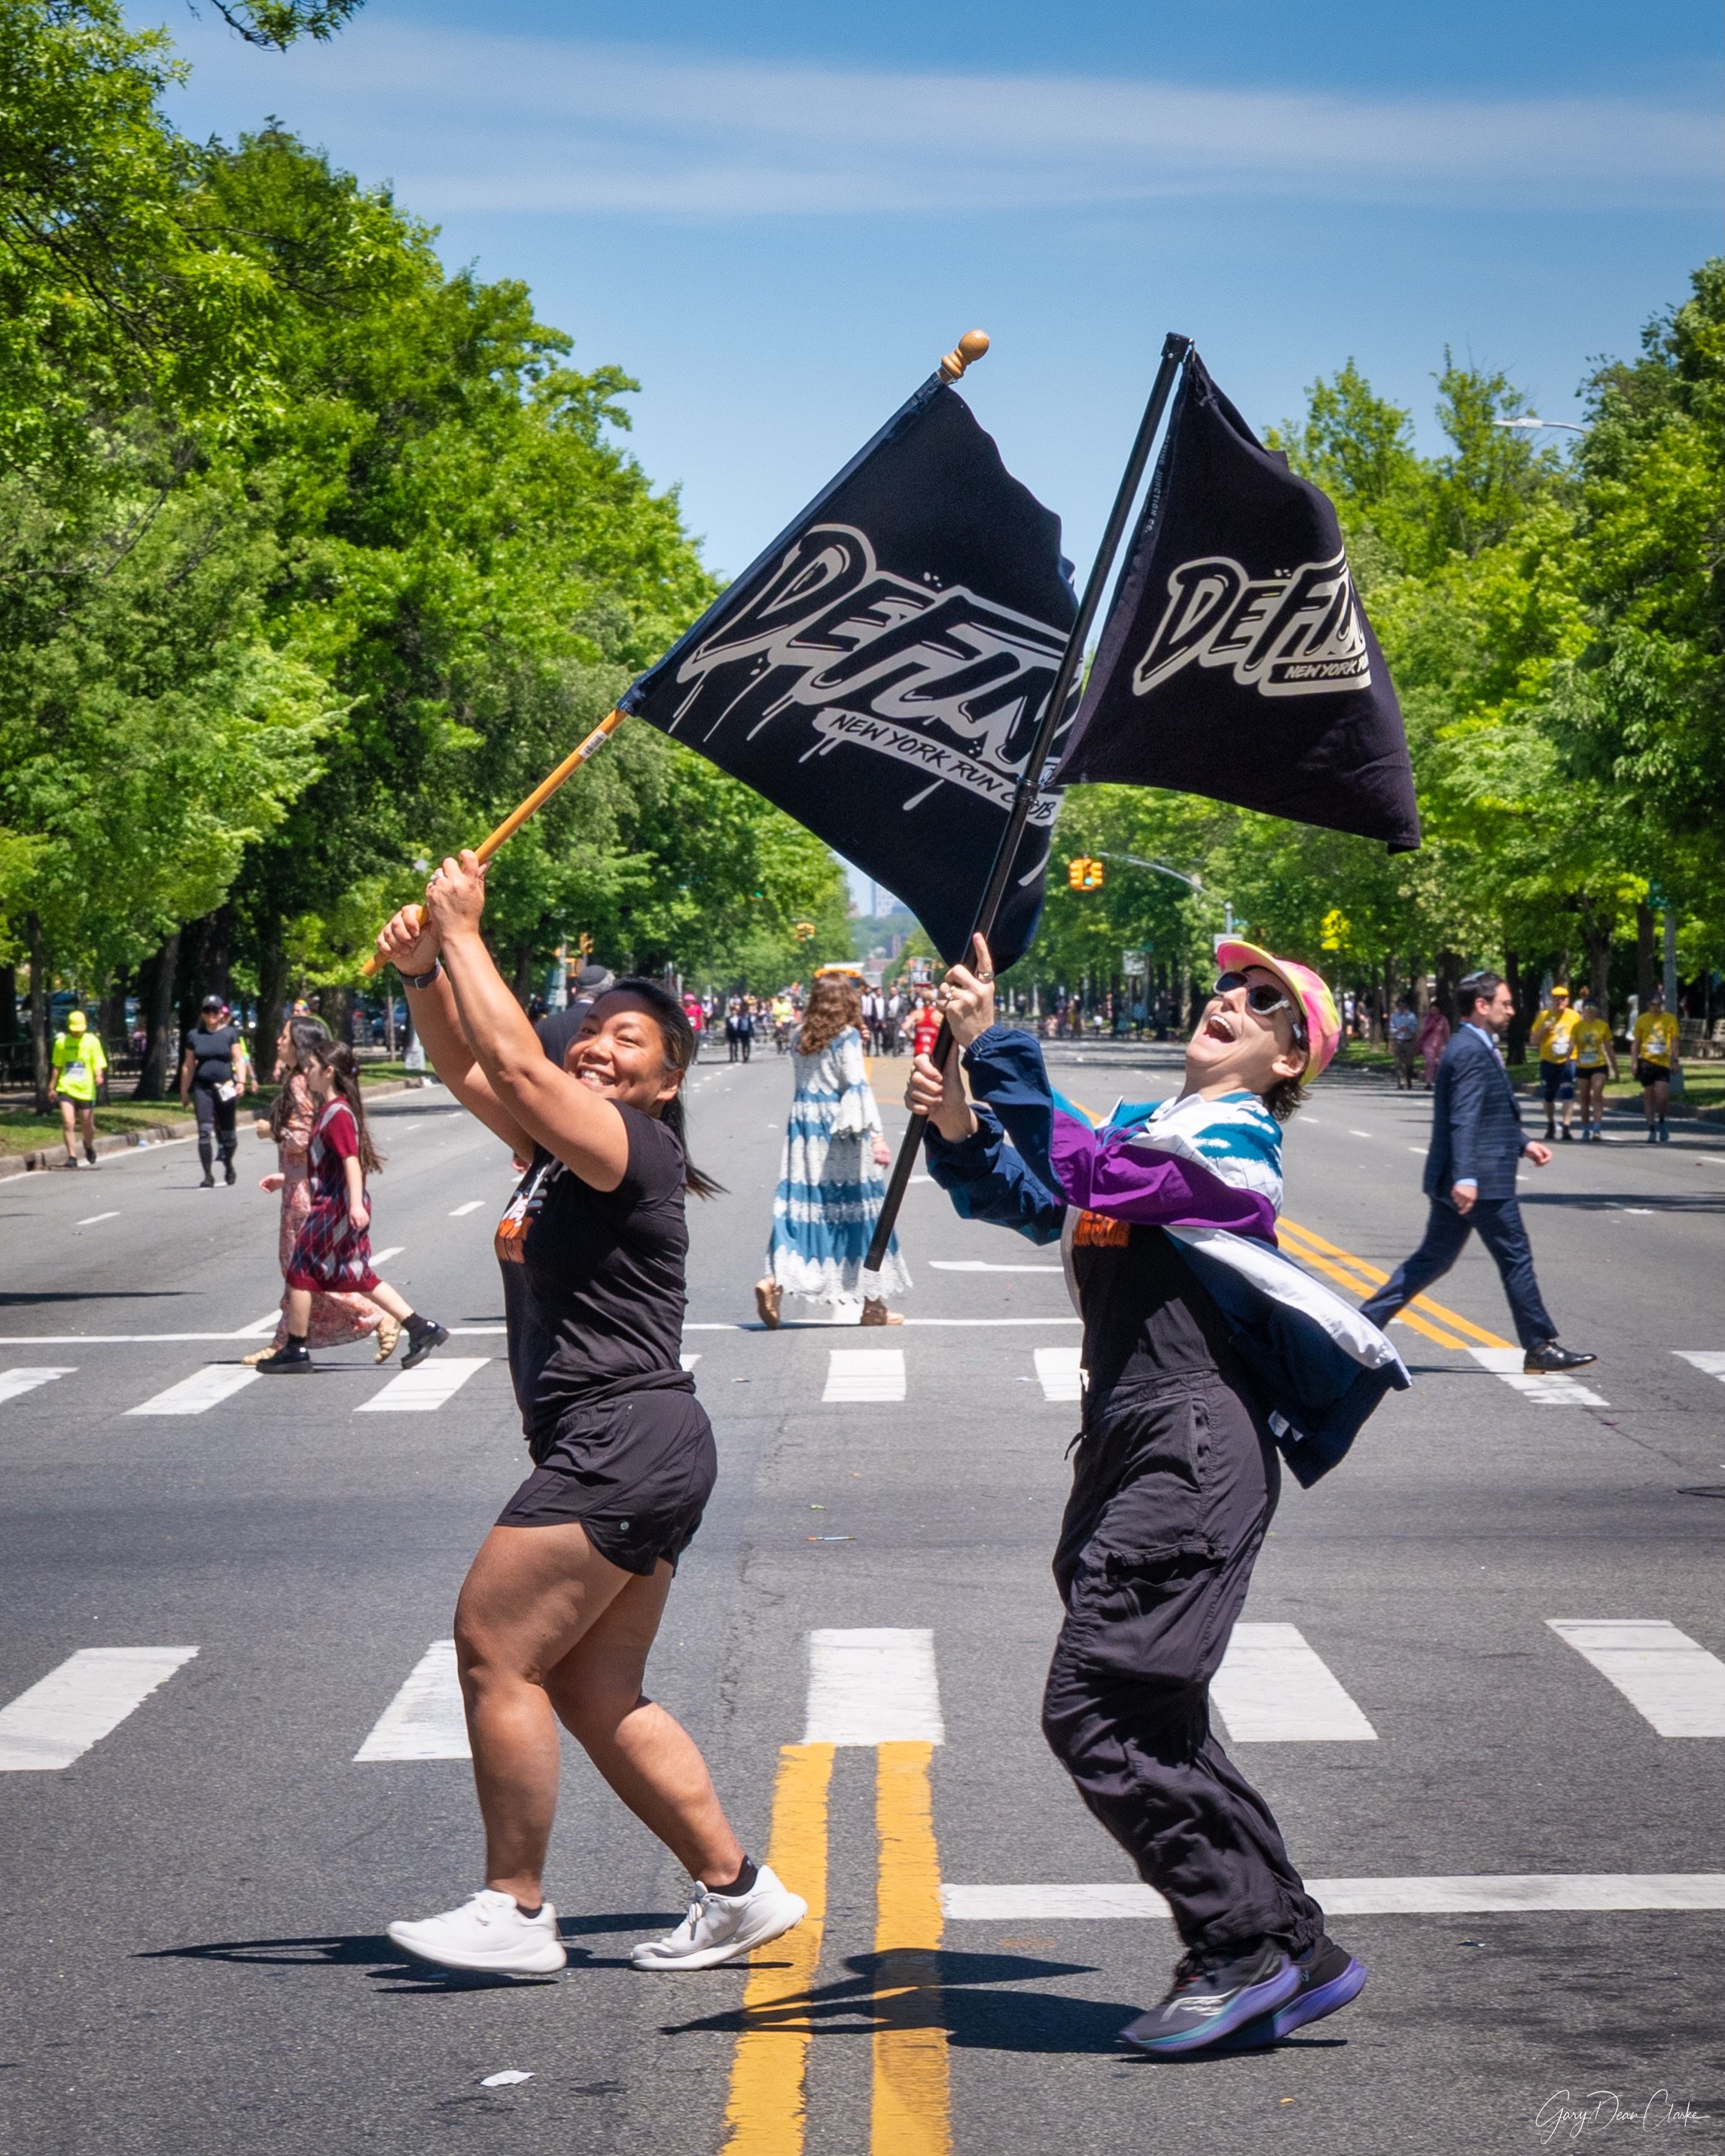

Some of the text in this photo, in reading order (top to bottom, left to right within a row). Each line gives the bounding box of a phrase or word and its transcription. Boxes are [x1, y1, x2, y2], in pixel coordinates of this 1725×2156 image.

[1151, 468, 1164, 517] JUNCTION
[1285, 664, 1323, 679] NEW
[1319, 659, 1358, 678] YORK
[828, 713, 890, 742] NEW
[883, 730, 952, 768] YORK
[947, 760, 1003, 792] RUN
